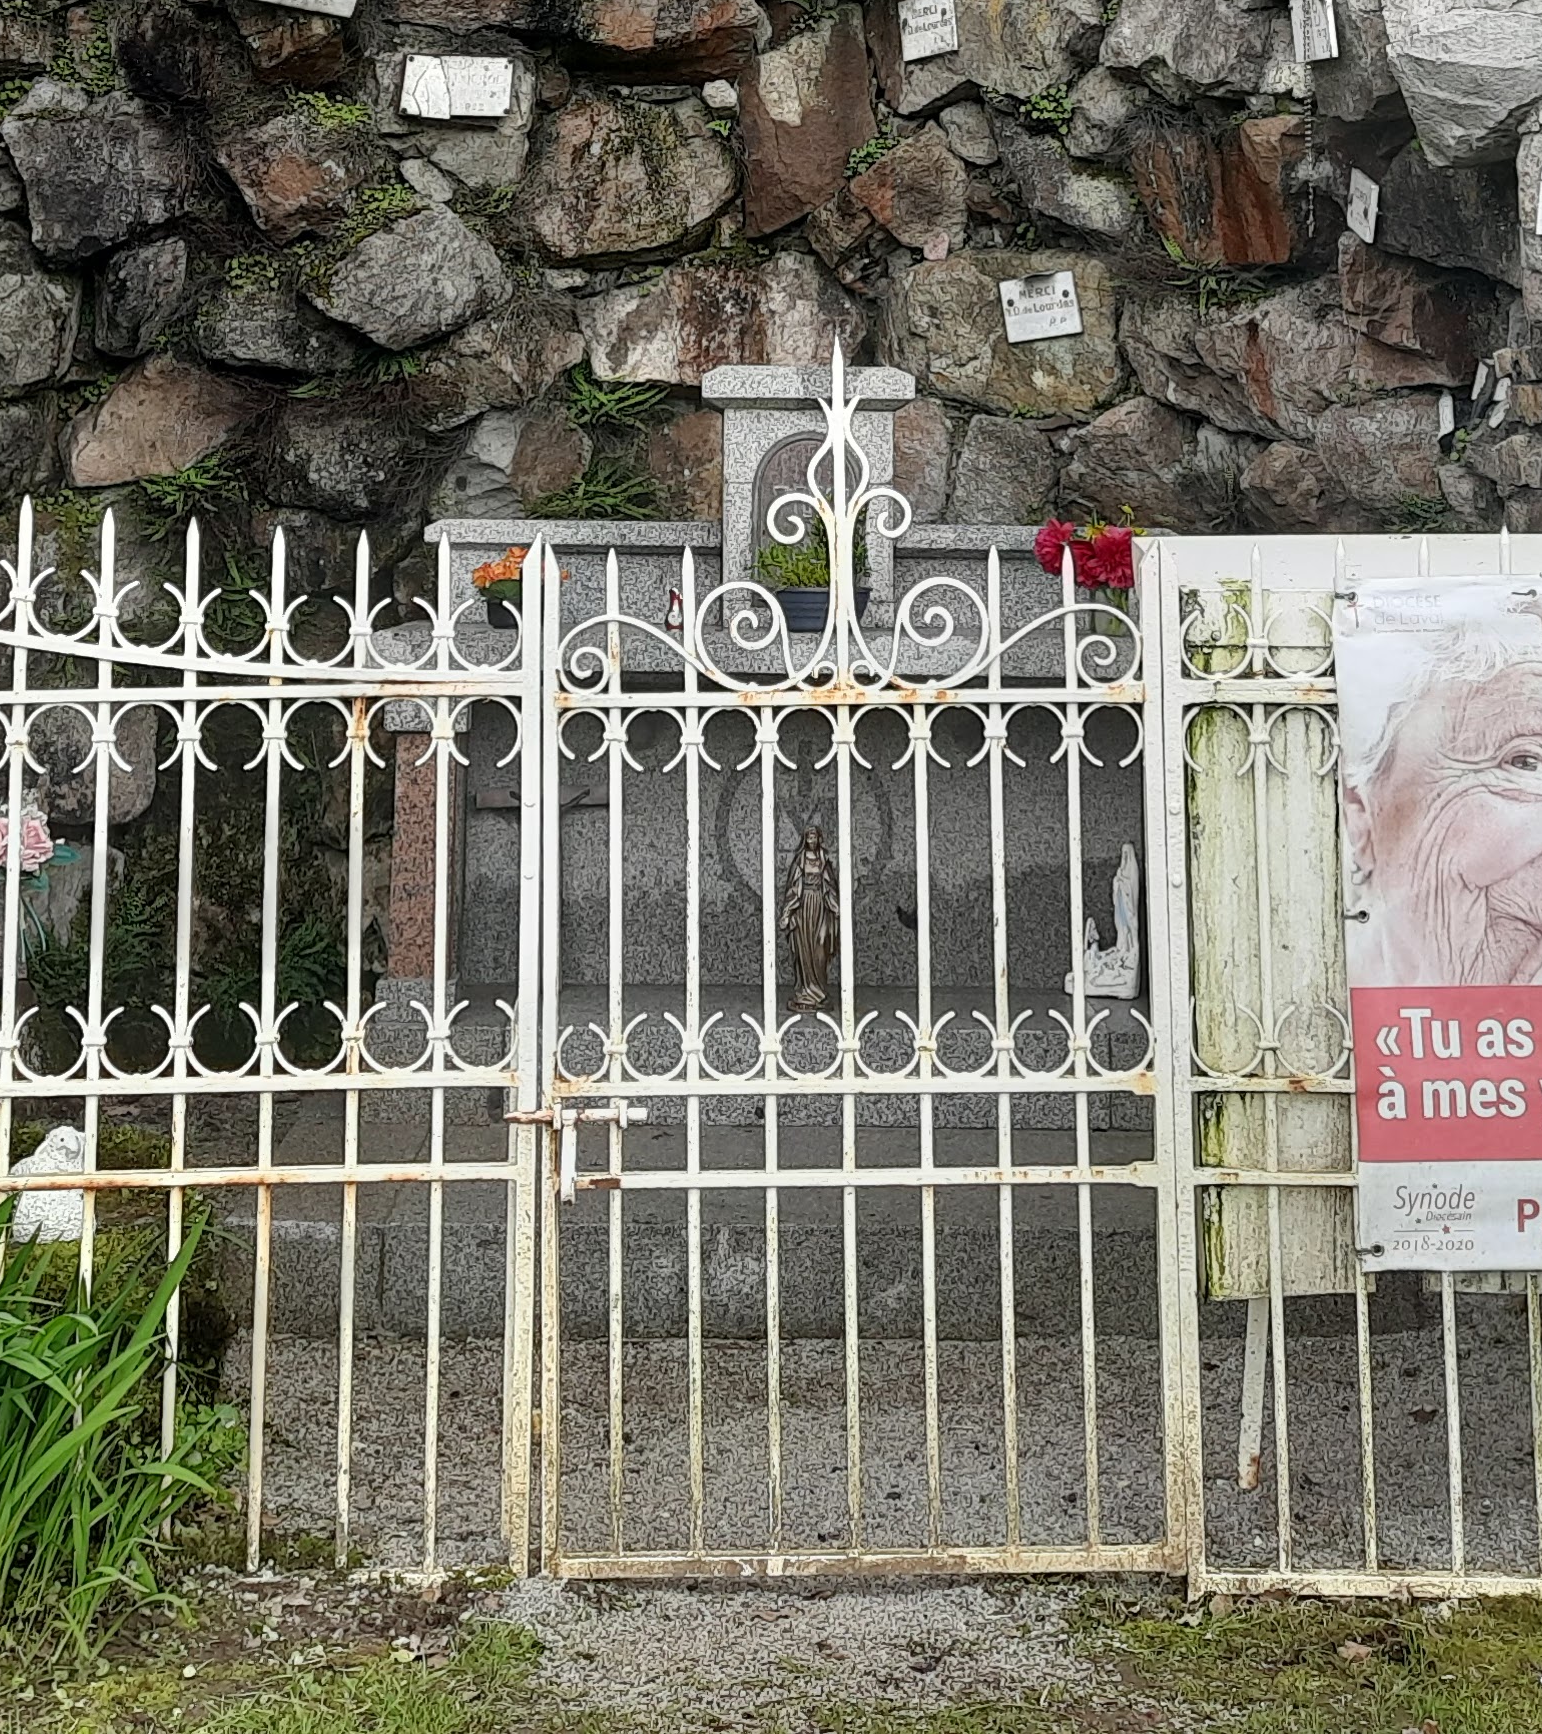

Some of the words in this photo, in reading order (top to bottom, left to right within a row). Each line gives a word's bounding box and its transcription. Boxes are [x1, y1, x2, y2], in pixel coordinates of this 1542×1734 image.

[1019, 285, 1056, 300] MERCI
[1374, 612, 1396, 625] de
[1400, 612, 1444, 625] Laval
[1375, 1007, 1461, 1059] «Tu
[1475, 1016, 1535, 1058] as
[1377, 1067, 1407, 1120] à
[1422, 1078, 1527, 1119] mes
[1392, 1183, 1476, 1217] Synode
[1392, 1234, 1475, 1251] 2018-2020
